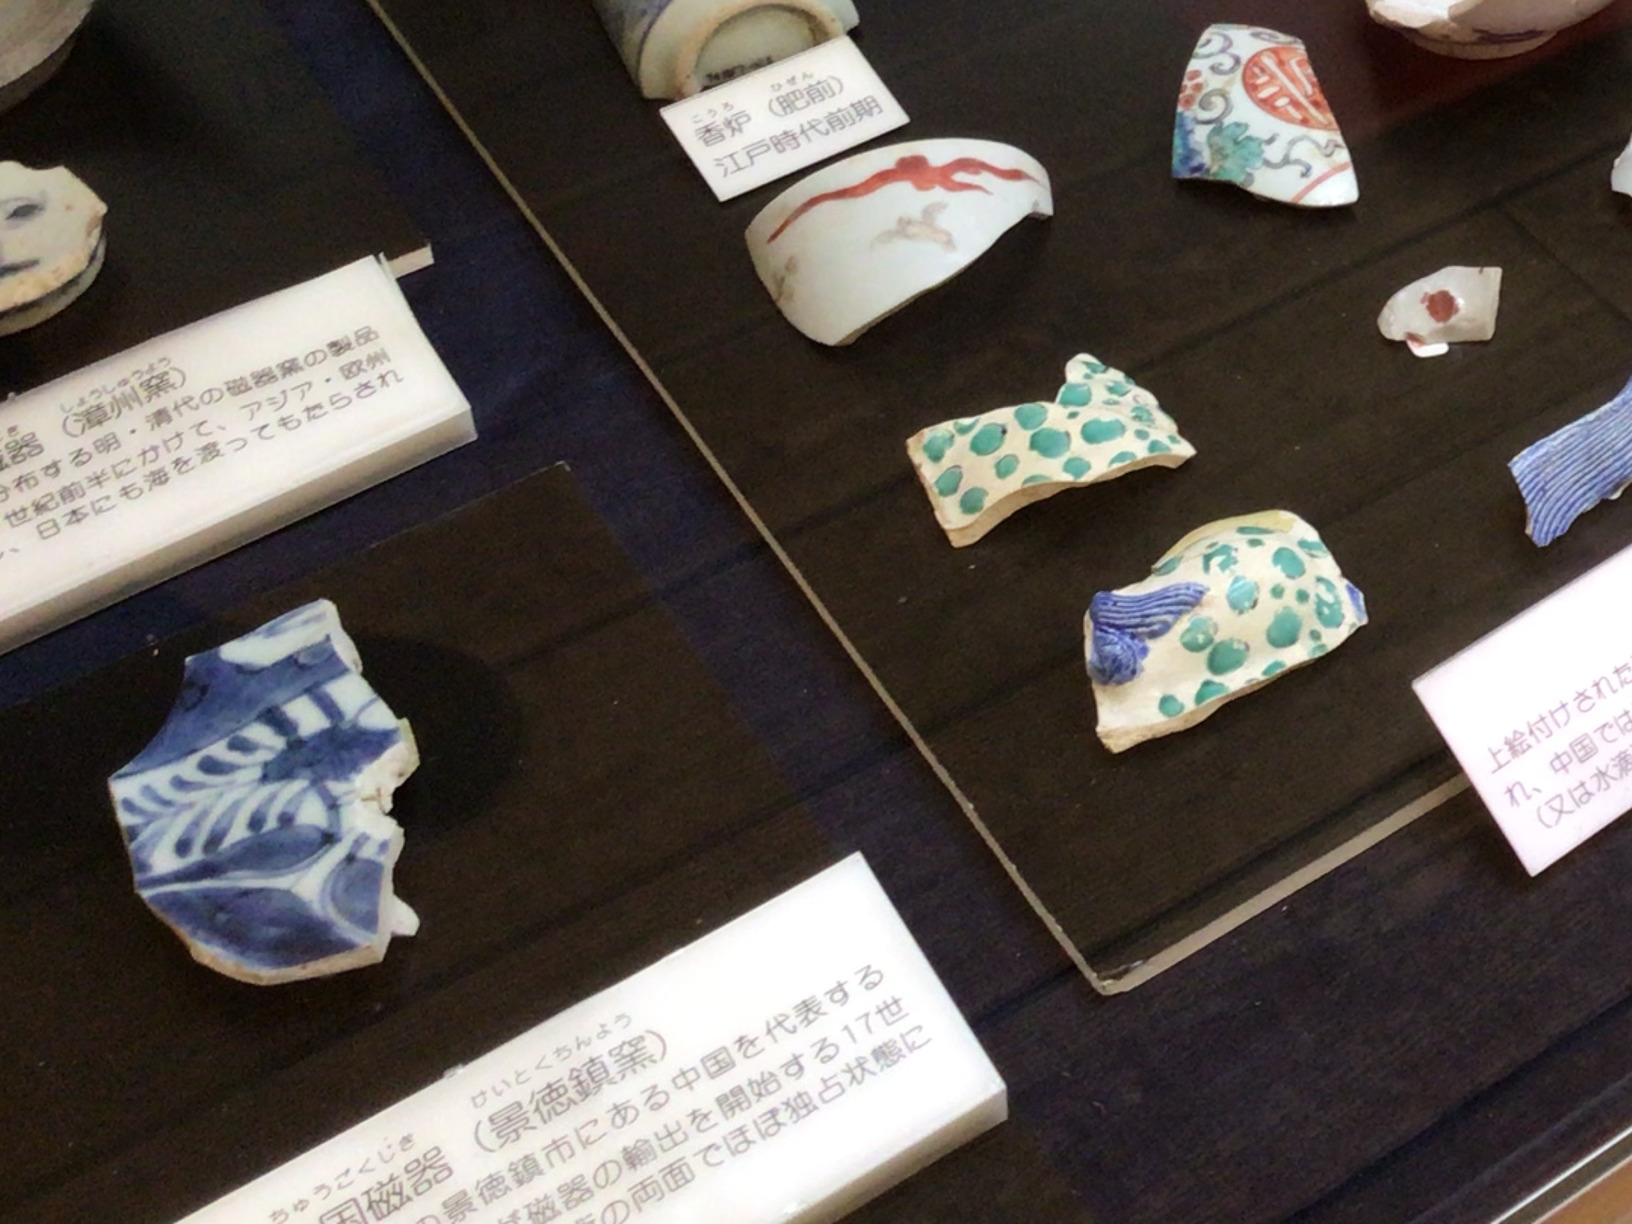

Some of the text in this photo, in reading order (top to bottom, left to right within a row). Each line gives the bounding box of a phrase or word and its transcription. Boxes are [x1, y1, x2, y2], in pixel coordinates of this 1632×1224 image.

[694, 75, 845, 148] 香炉 （肥前）
[712, 94, 884, 178] 江戸時代前期
[0, 369, 405, 560] 、日本にも海を渡ってもたらされ
[473, 1028, 667, 1154] （景徳鎮窯）
